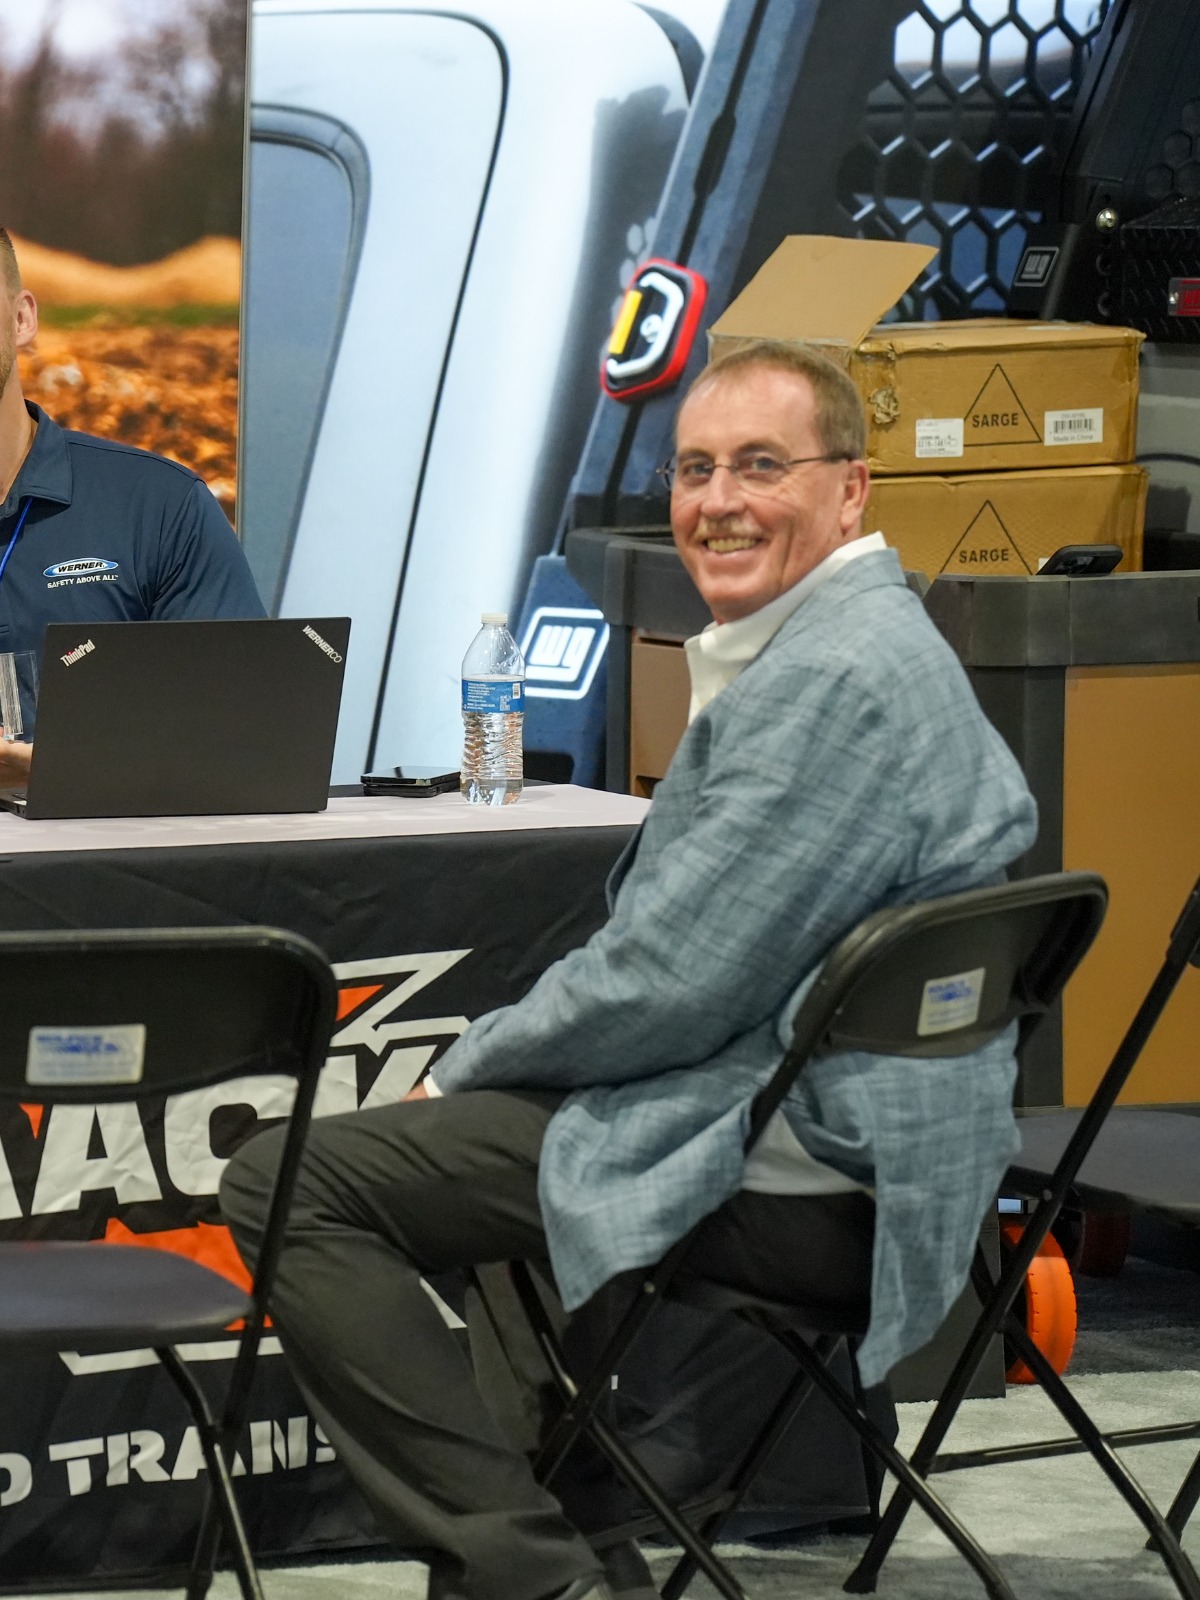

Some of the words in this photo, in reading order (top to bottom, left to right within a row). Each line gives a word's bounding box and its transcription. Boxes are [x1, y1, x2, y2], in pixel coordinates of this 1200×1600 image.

[972, 412, 1019, 429] SARGE
[958, 548, 1009, 564] SARGE
[58, 561, 105, 573] WERNER
[47, 578, 75, 589] SAFETY
[76, 575, 101, 585] ABOVE
[302, 624, 343, 664] WERNERCO
[59, 638, 96, 667] ThinkPad
